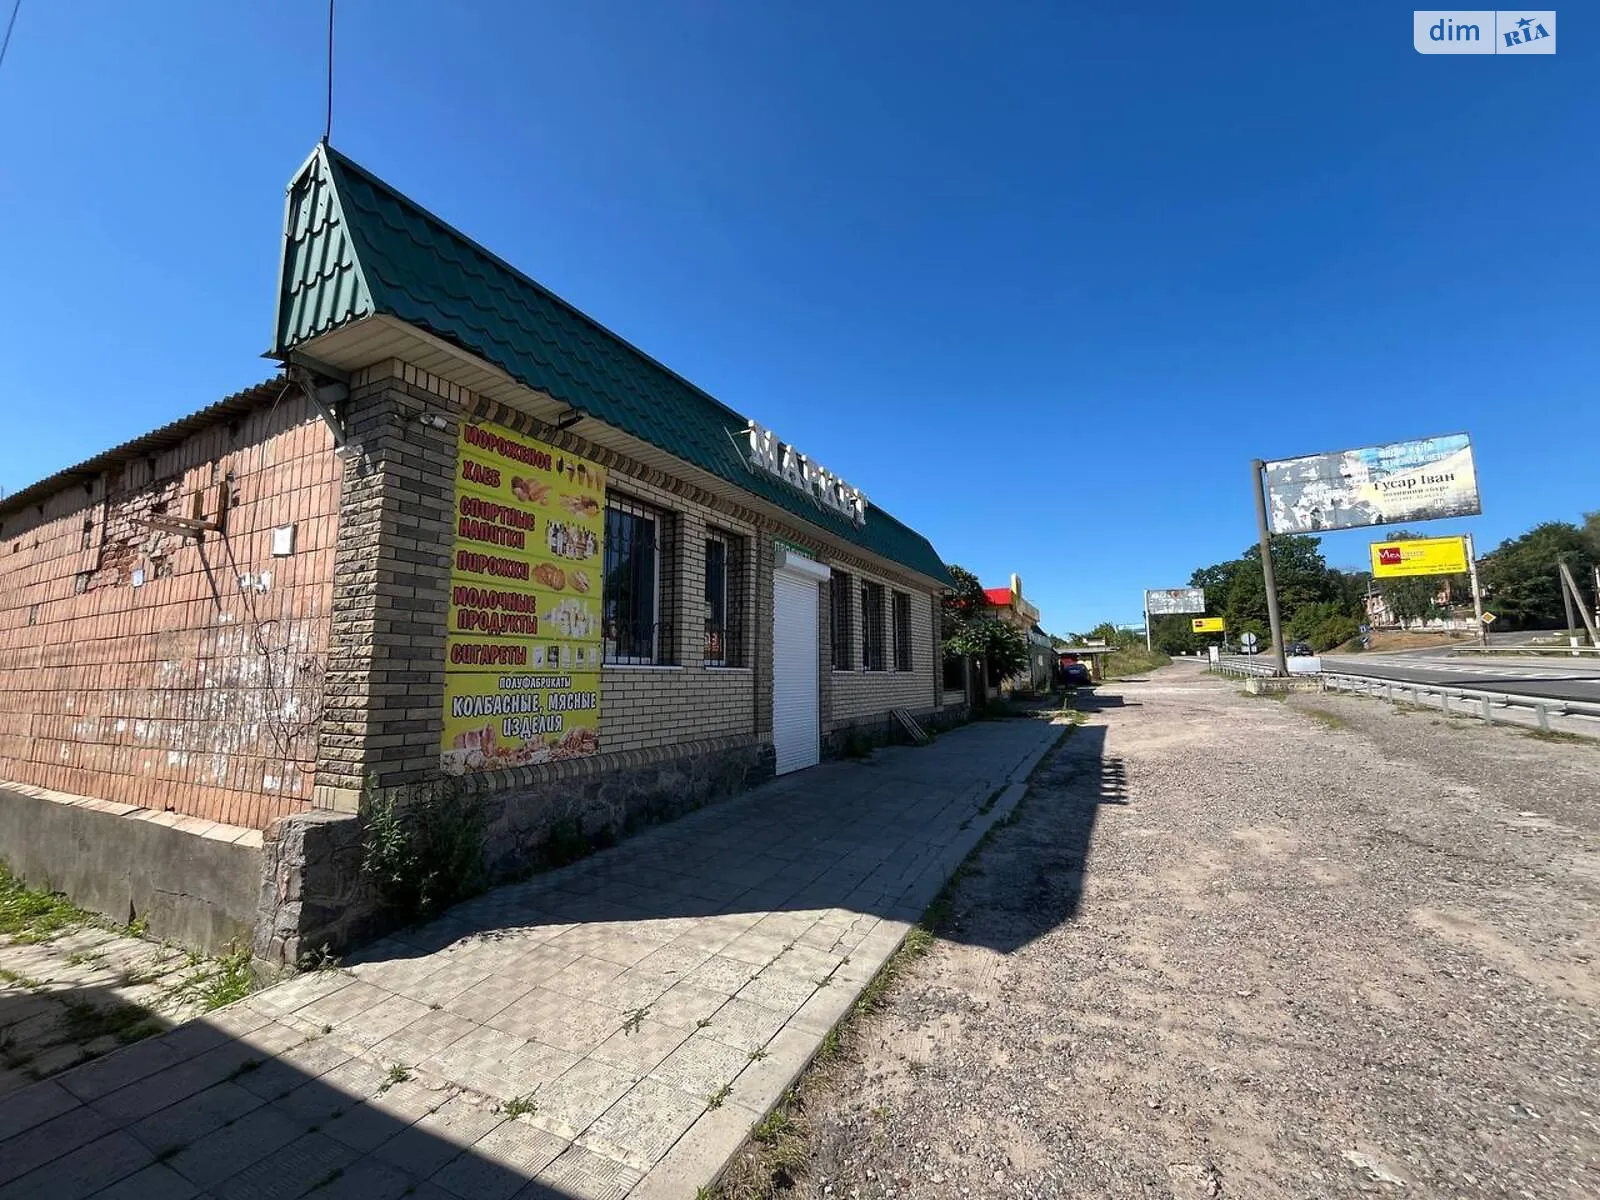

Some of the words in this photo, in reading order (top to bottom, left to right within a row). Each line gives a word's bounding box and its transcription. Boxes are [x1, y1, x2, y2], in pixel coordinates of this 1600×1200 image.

[464, 424, 551, 471] МОРОЖЕНОЕ
[462, 460, 501, 487] ХЛЕБ
[460, 496, 535, 531] СПИРТНЫЕ
[459, 518, 524, 549] НАПИТКИ
[457, 550, 529, 581] ПИРОЖКИ
[453, 586, 536, 613] МОЛОЧНЫЕ
[457, 609, 537, 635] ПРОДУКТЫ
[451, 643, 527, 665] СИГАРЕТЫ
[499, 676, 571, 690] ПОЛУФАБРИКАТЫ
[452, 694, 544, 718] КОЛБАСНЫЕ,
[548, 691, 597, 711] МЯСНЫЕ
[502, 715, 563, 739] ИЗДЕЛИЯ
